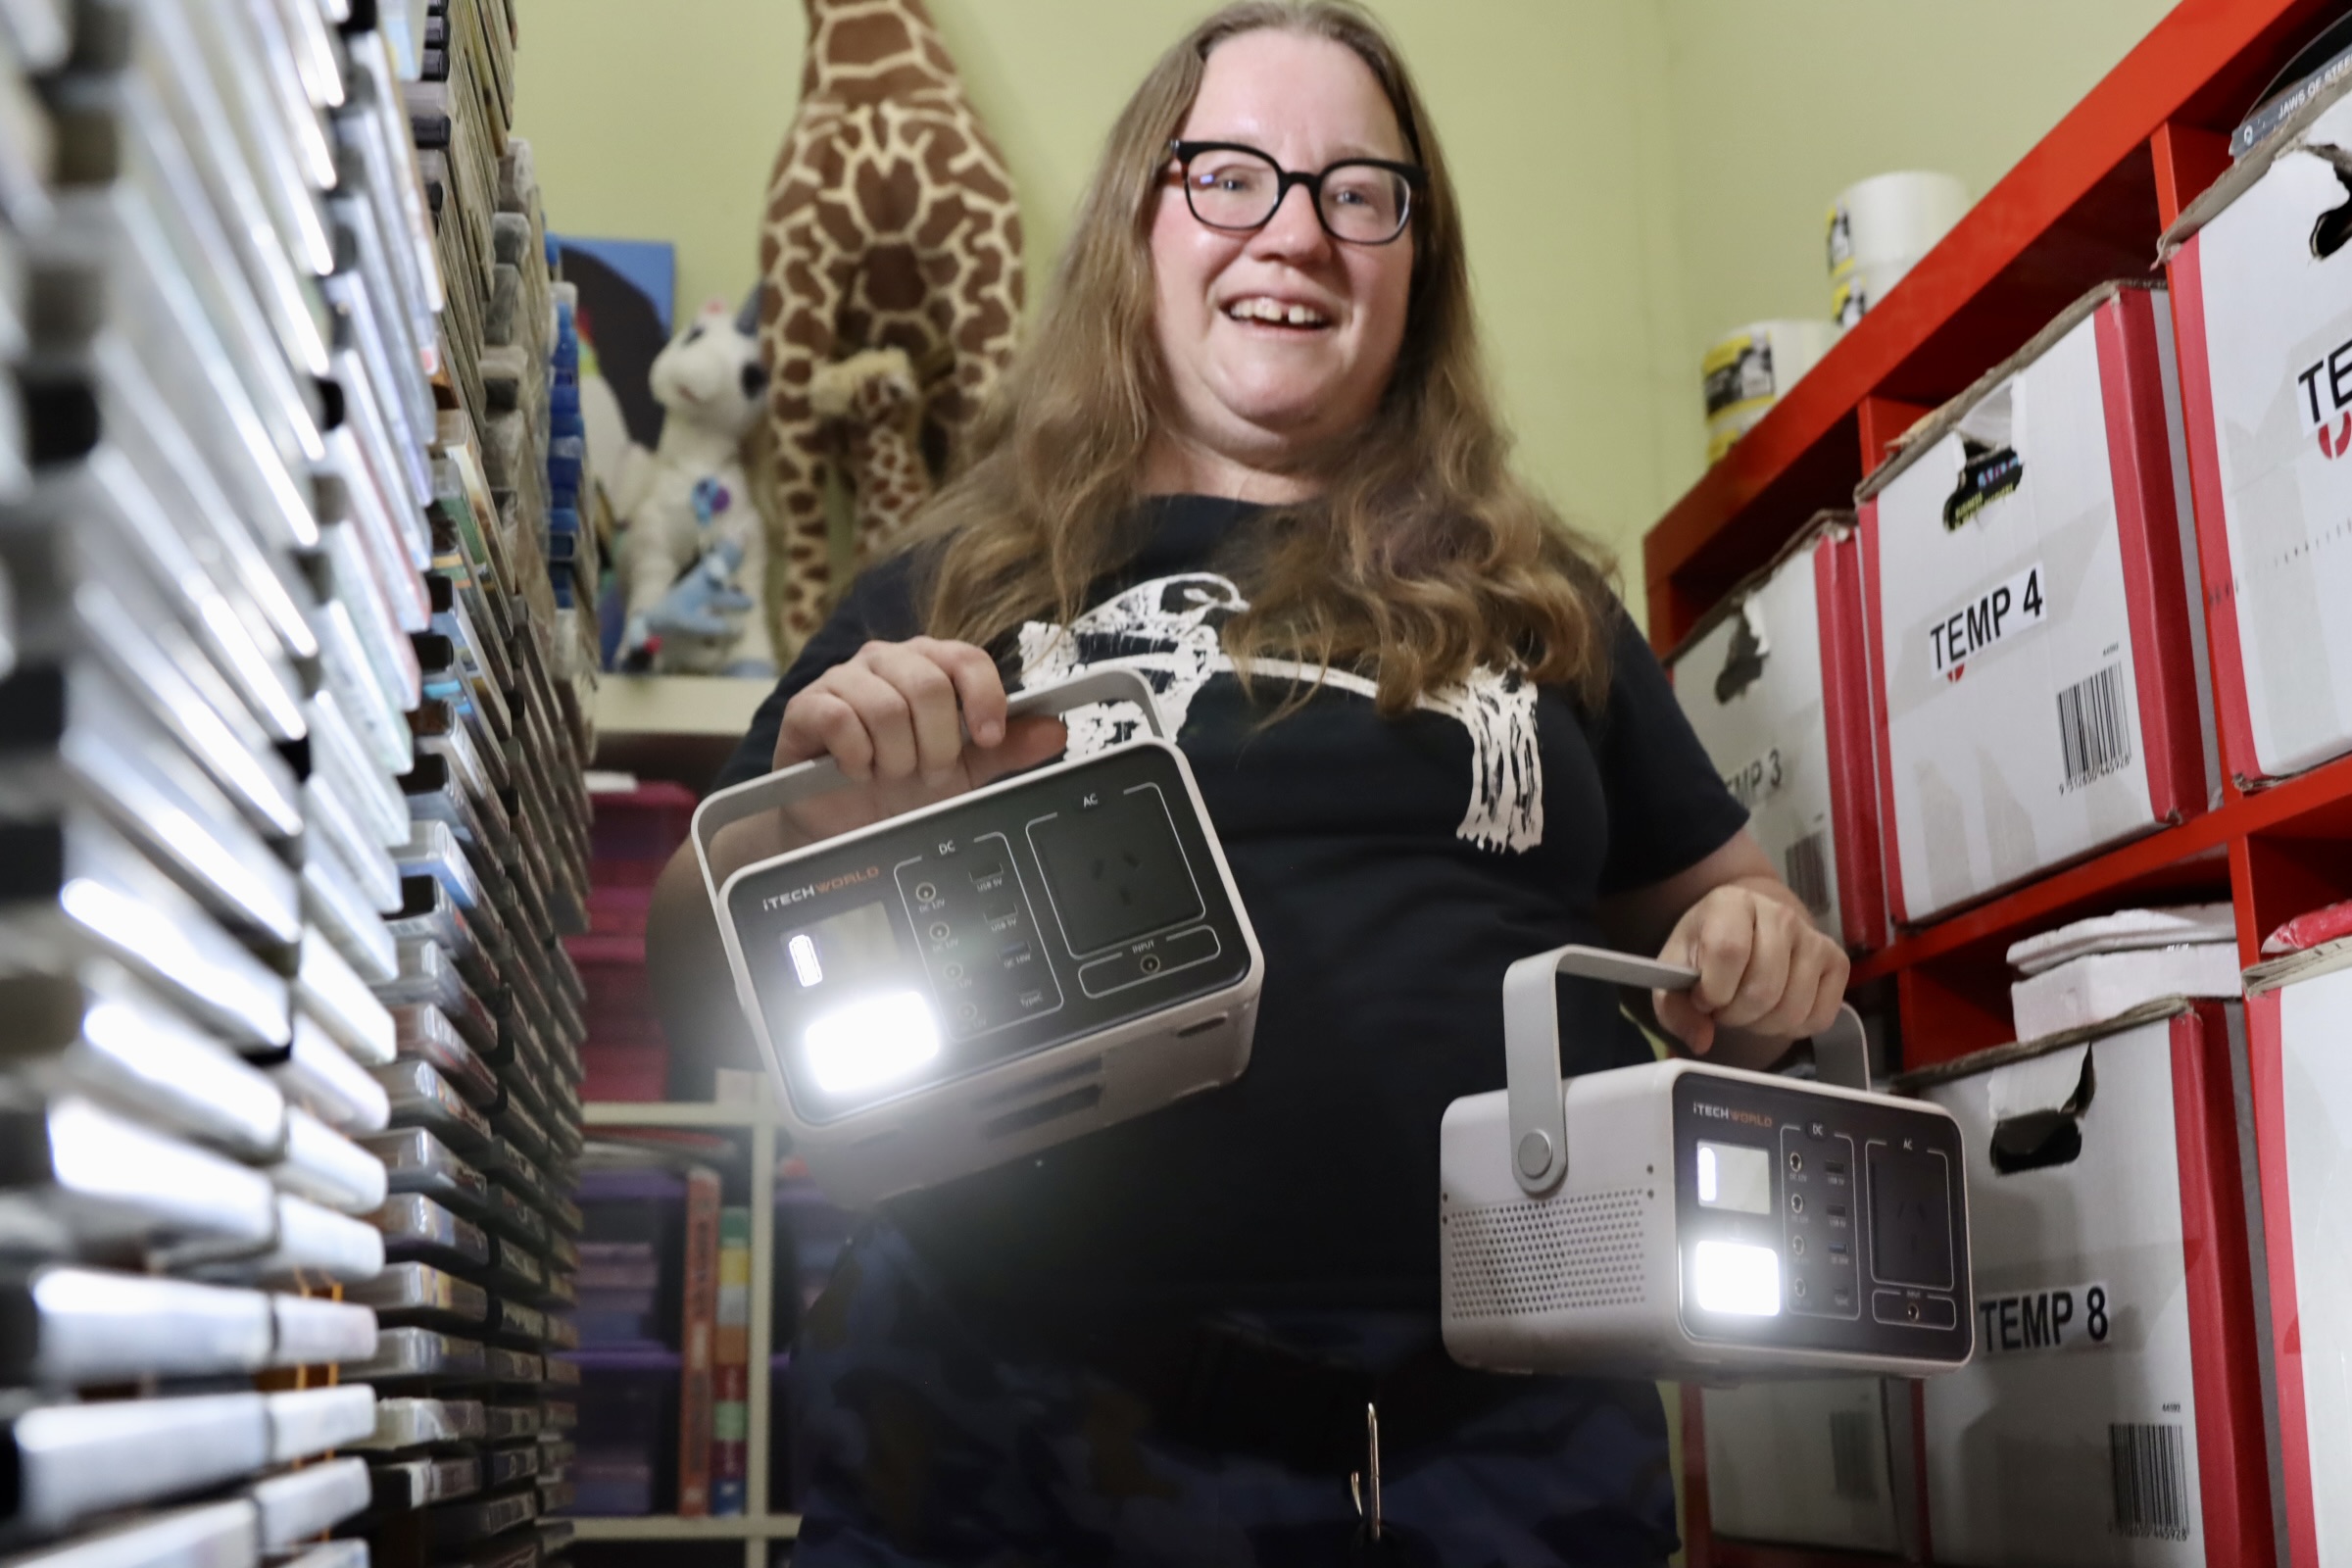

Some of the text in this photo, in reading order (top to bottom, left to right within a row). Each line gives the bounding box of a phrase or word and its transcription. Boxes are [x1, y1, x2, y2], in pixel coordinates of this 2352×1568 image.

[2278, 89, 2305, 120] JAWS
[2307, 76, 2322, 98] OF
[1930, 567, 2043, 671] TEMP 4
[1768, 749, 1783, 788] 3
[1083, 793, 1099, 808] AC
[938, 840, 956, 856] DC
[1131, 938, 1155, 955] INPUT
[1812, 1122, 1824, 1137] DC
[1903, 1138, 1913, 1152] AC
[1979, 1286, 2109, 1352] TEMP 8
